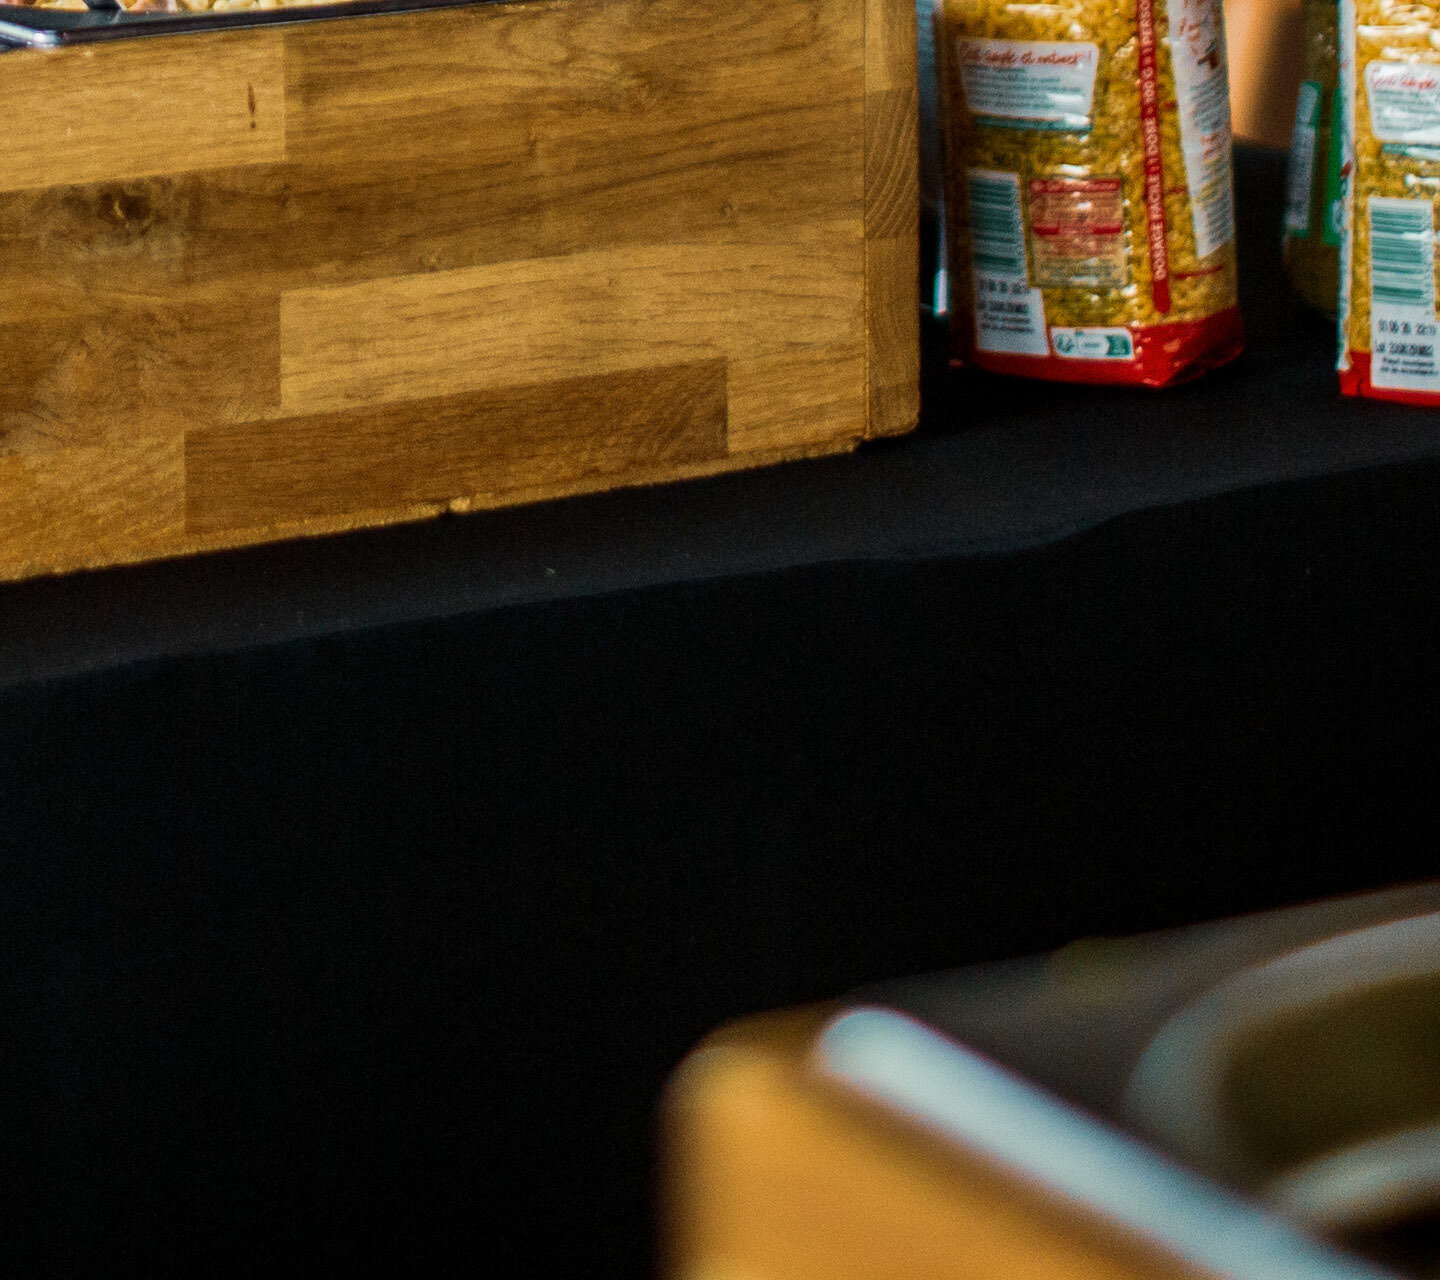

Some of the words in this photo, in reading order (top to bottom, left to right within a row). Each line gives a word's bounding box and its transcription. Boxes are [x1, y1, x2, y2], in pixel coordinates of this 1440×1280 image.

[1144, 118, 1161, 156] DOSE
[1146, 175, 1164, 221] FACILE
[1149, 222, 1166, 280] DOSAGE
